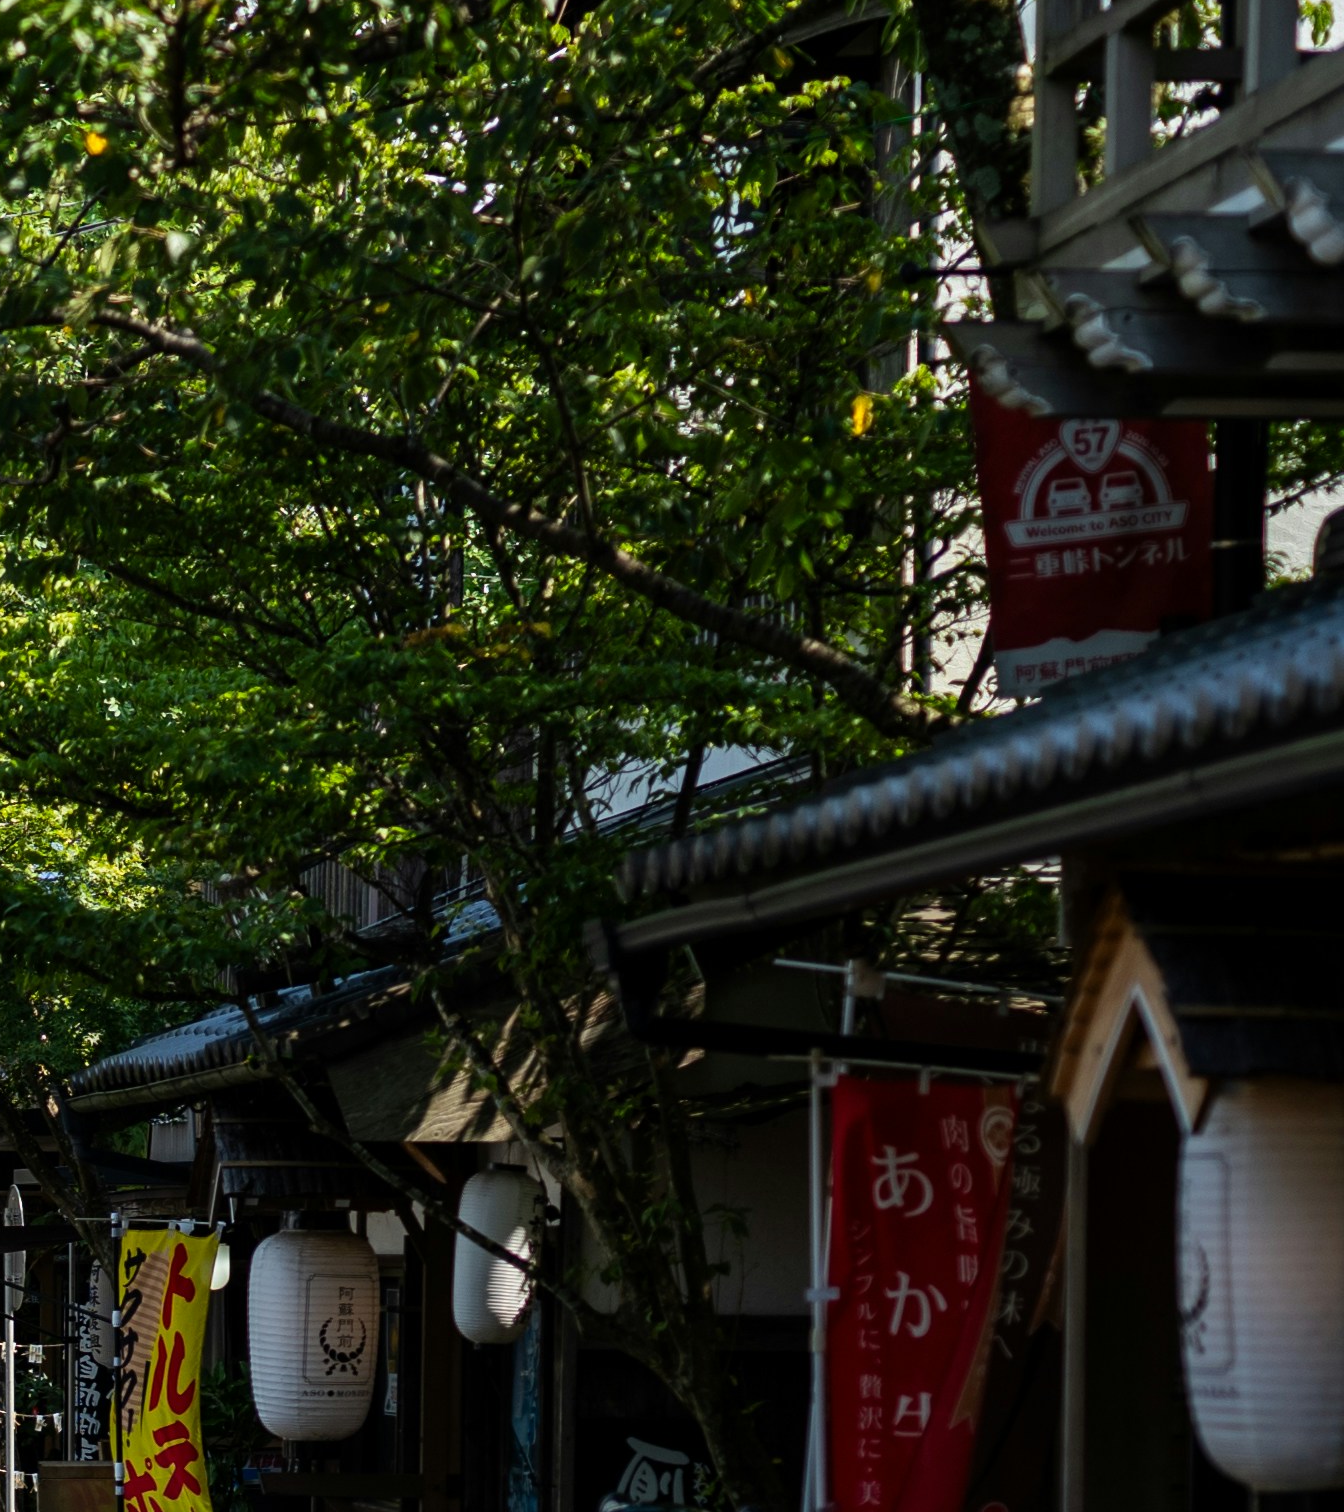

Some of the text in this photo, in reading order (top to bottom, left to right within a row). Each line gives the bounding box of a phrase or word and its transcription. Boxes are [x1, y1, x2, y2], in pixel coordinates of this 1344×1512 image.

[1073, 426, 1110, 457] 57
[1026, 509, 1174, 539] Welcome to ASO CITY
[1008, 537, 1191, 580] 二重峠トンネル
[337, 1285, 356, 1349] 阿蘇門前
[301, 1390, 326, 1398] ASO
